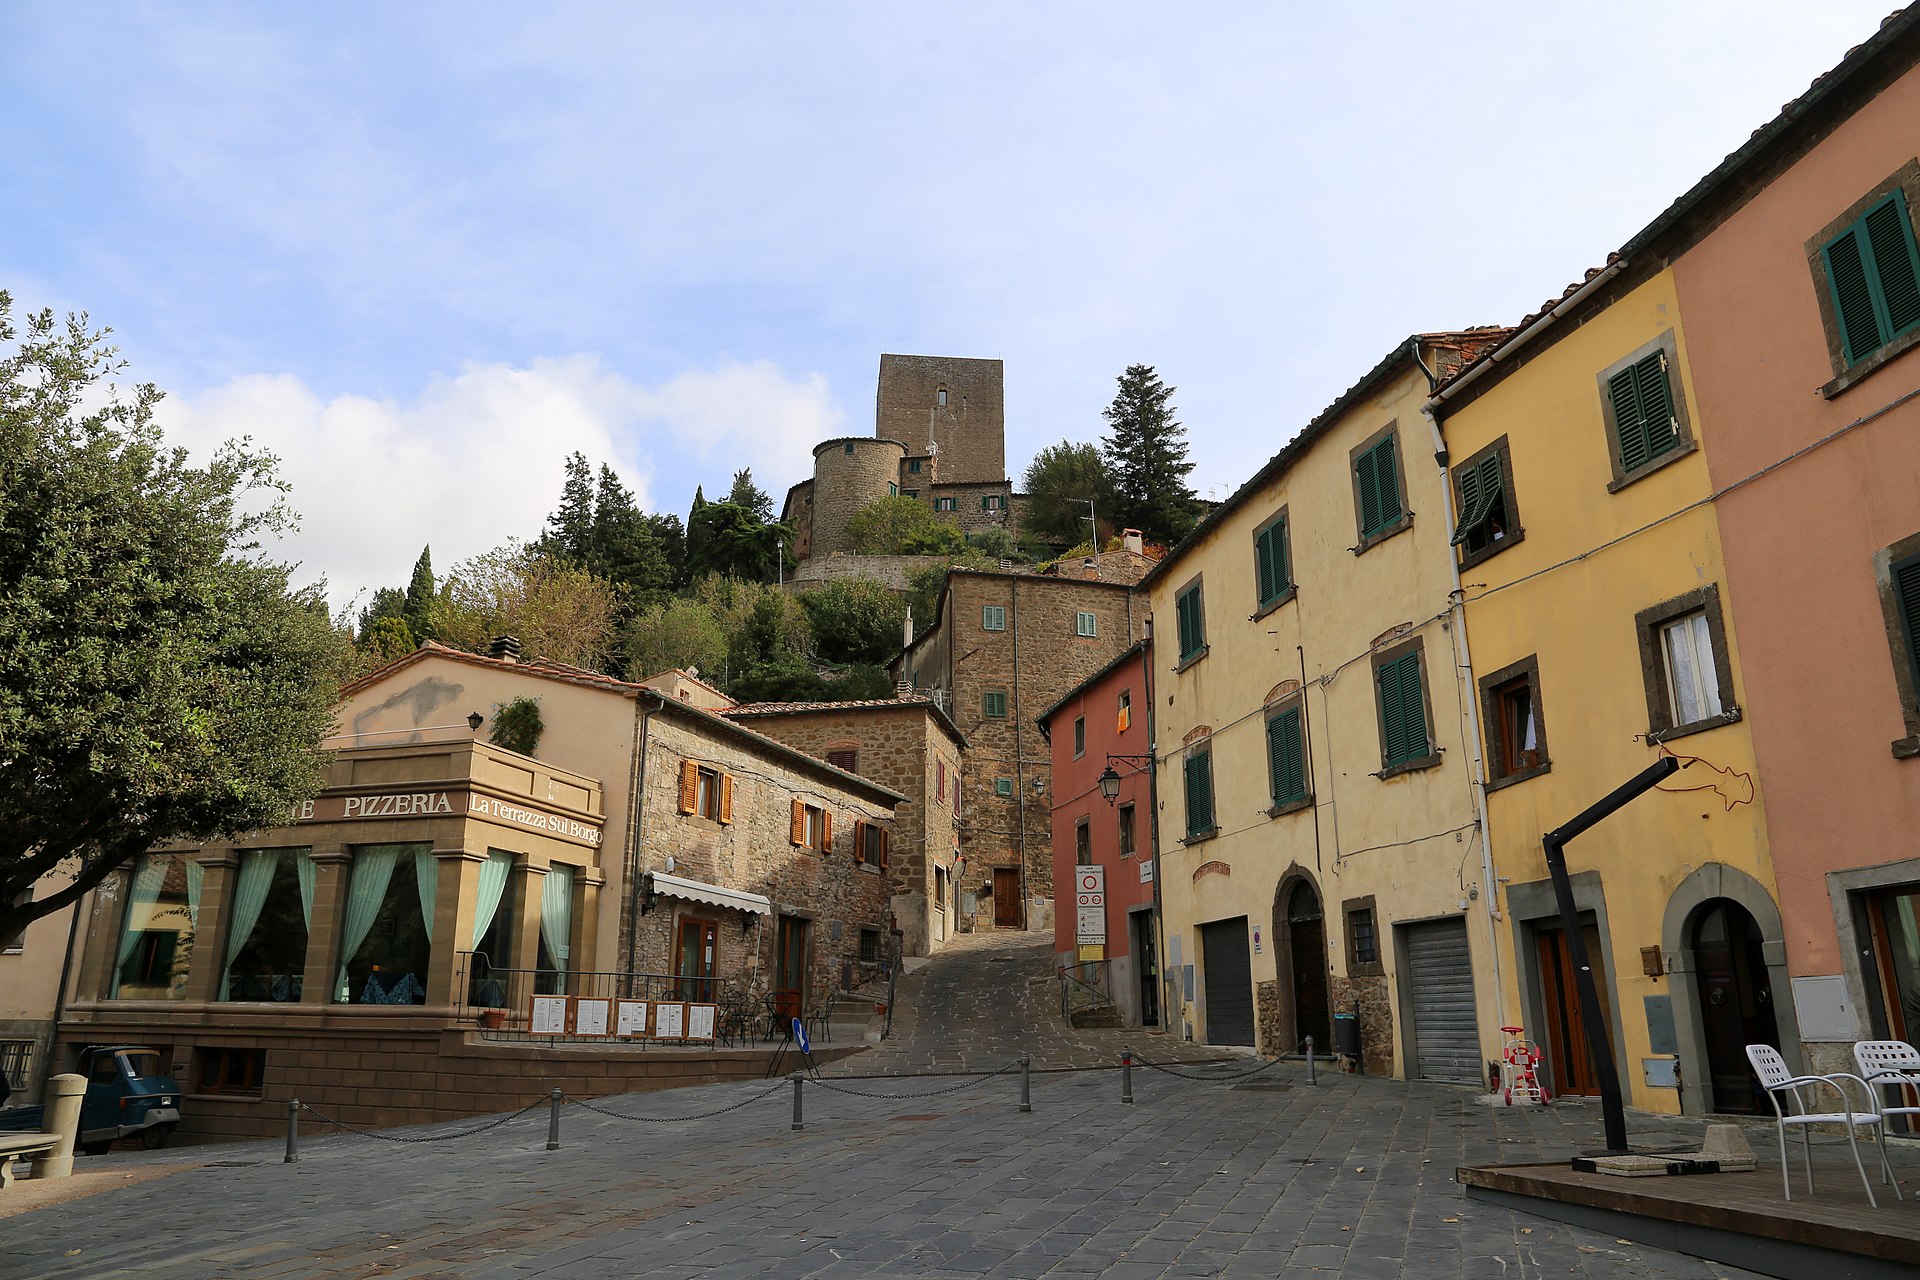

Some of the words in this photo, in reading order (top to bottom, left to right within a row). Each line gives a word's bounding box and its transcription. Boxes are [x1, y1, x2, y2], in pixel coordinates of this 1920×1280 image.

[342, 792, 454, 818] PIZZERIA
[469, 794, 489, 814] La
[490, 799, 547, 829] Terrazza
[547, 815, 569, 835] Sul
[568, 821, 603, 844] Borgo
